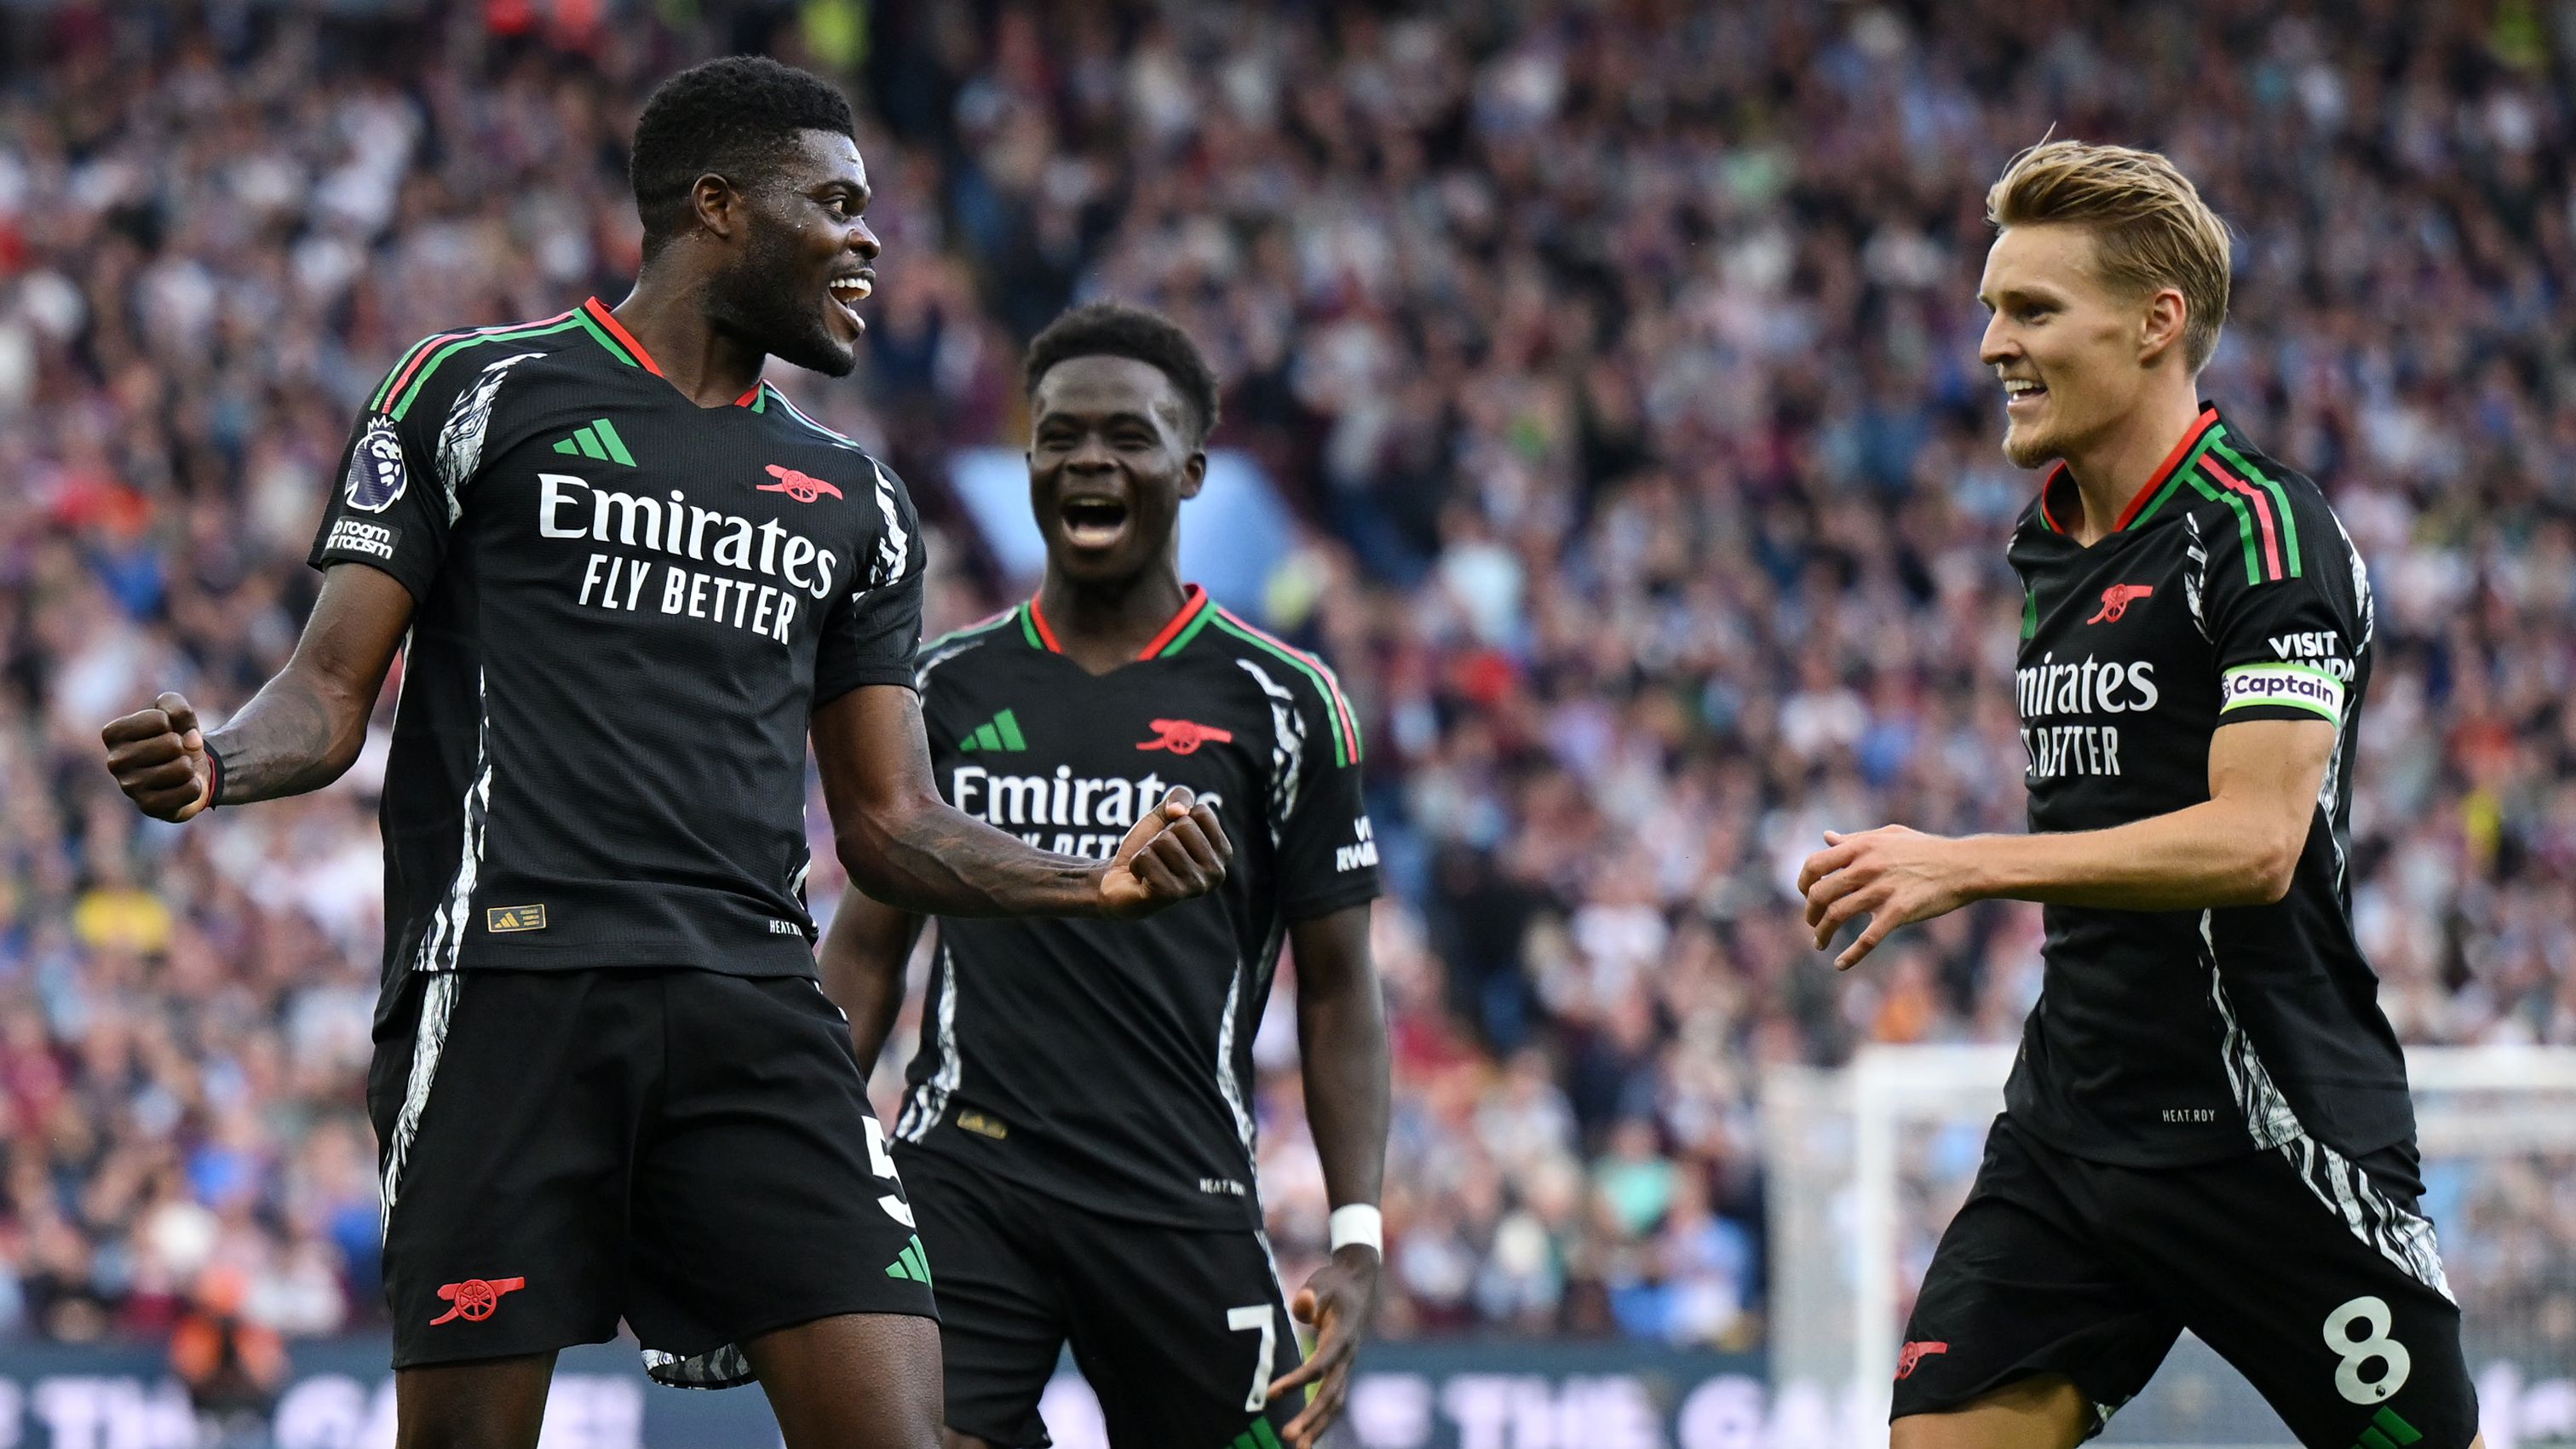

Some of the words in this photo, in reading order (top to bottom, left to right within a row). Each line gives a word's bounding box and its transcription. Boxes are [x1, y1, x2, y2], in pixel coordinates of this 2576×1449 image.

[336, 534, 393, 559] racism
[342, 520, 390, 543] room
[538, 473, 837, 599] Emirates
[578, 554, 651, 611] FLY
[661, 566, 796, 645] BETTER
[2268, 630, 2337, 659] VISIT
[2015, 651, 2159, 718] mirates
[2234, 676, 2333, 706] Captain
[2037, 726, 2120, 777] BETTER
[953, 764, 1223, 826] Emirat
[861, 1115, 916, 1228] 5
[1227, 1303, 1276, 1412] 7
[2323, 1296, 2410, 1405] 8
